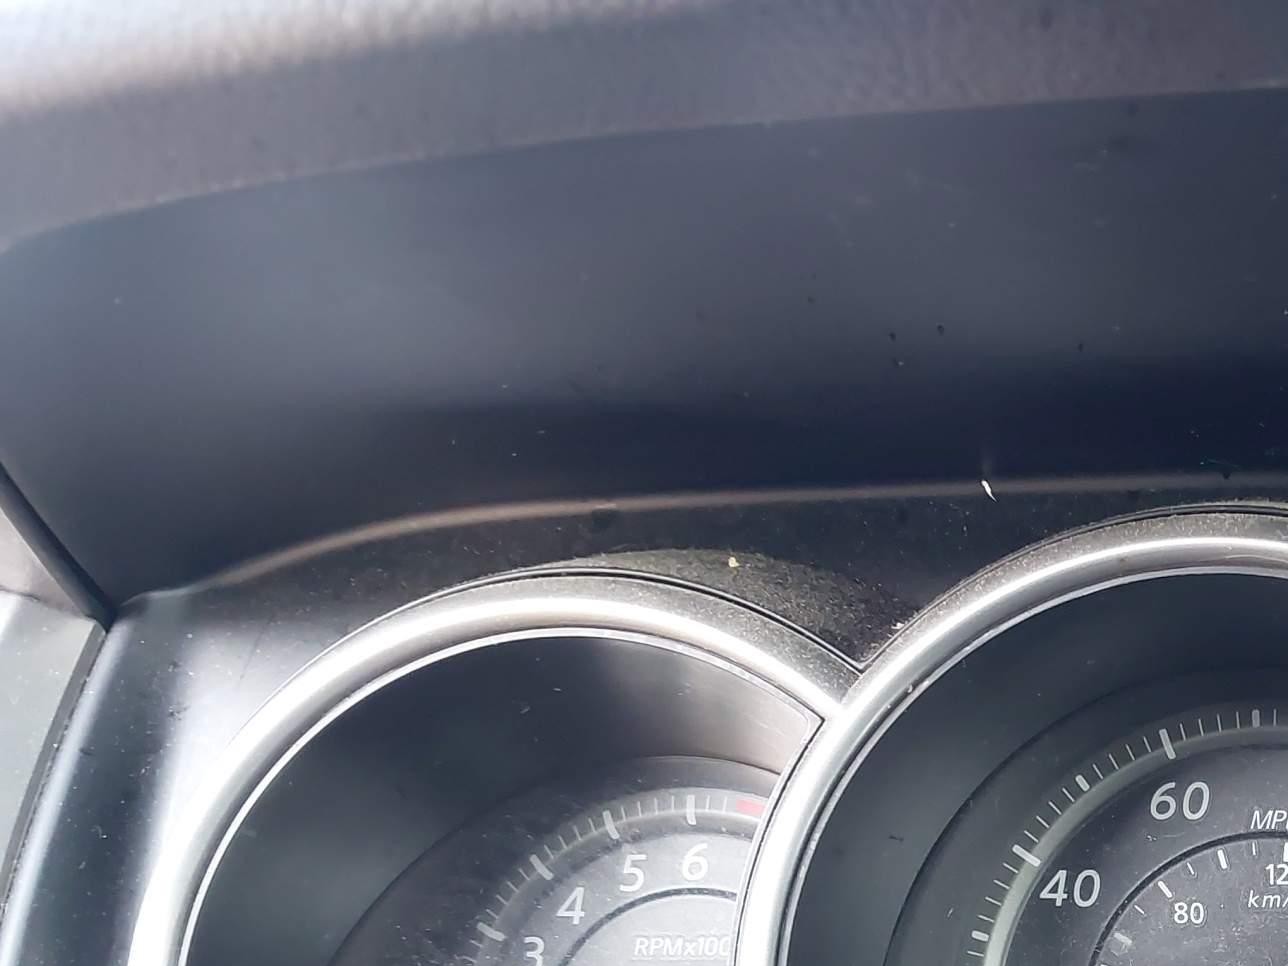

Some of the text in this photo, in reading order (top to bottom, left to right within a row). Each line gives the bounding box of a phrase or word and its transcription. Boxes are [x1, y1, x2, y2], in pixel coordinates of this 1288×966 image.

[1150, 781, 1210, 821] 60
[619, 854, 647, 892] 5
[682, 843, 708, 881] 6
[556, 887, 585, 925] 4
[1039, 869, 1101, 908] 40
[1173, 902, 1205, 924] 80
